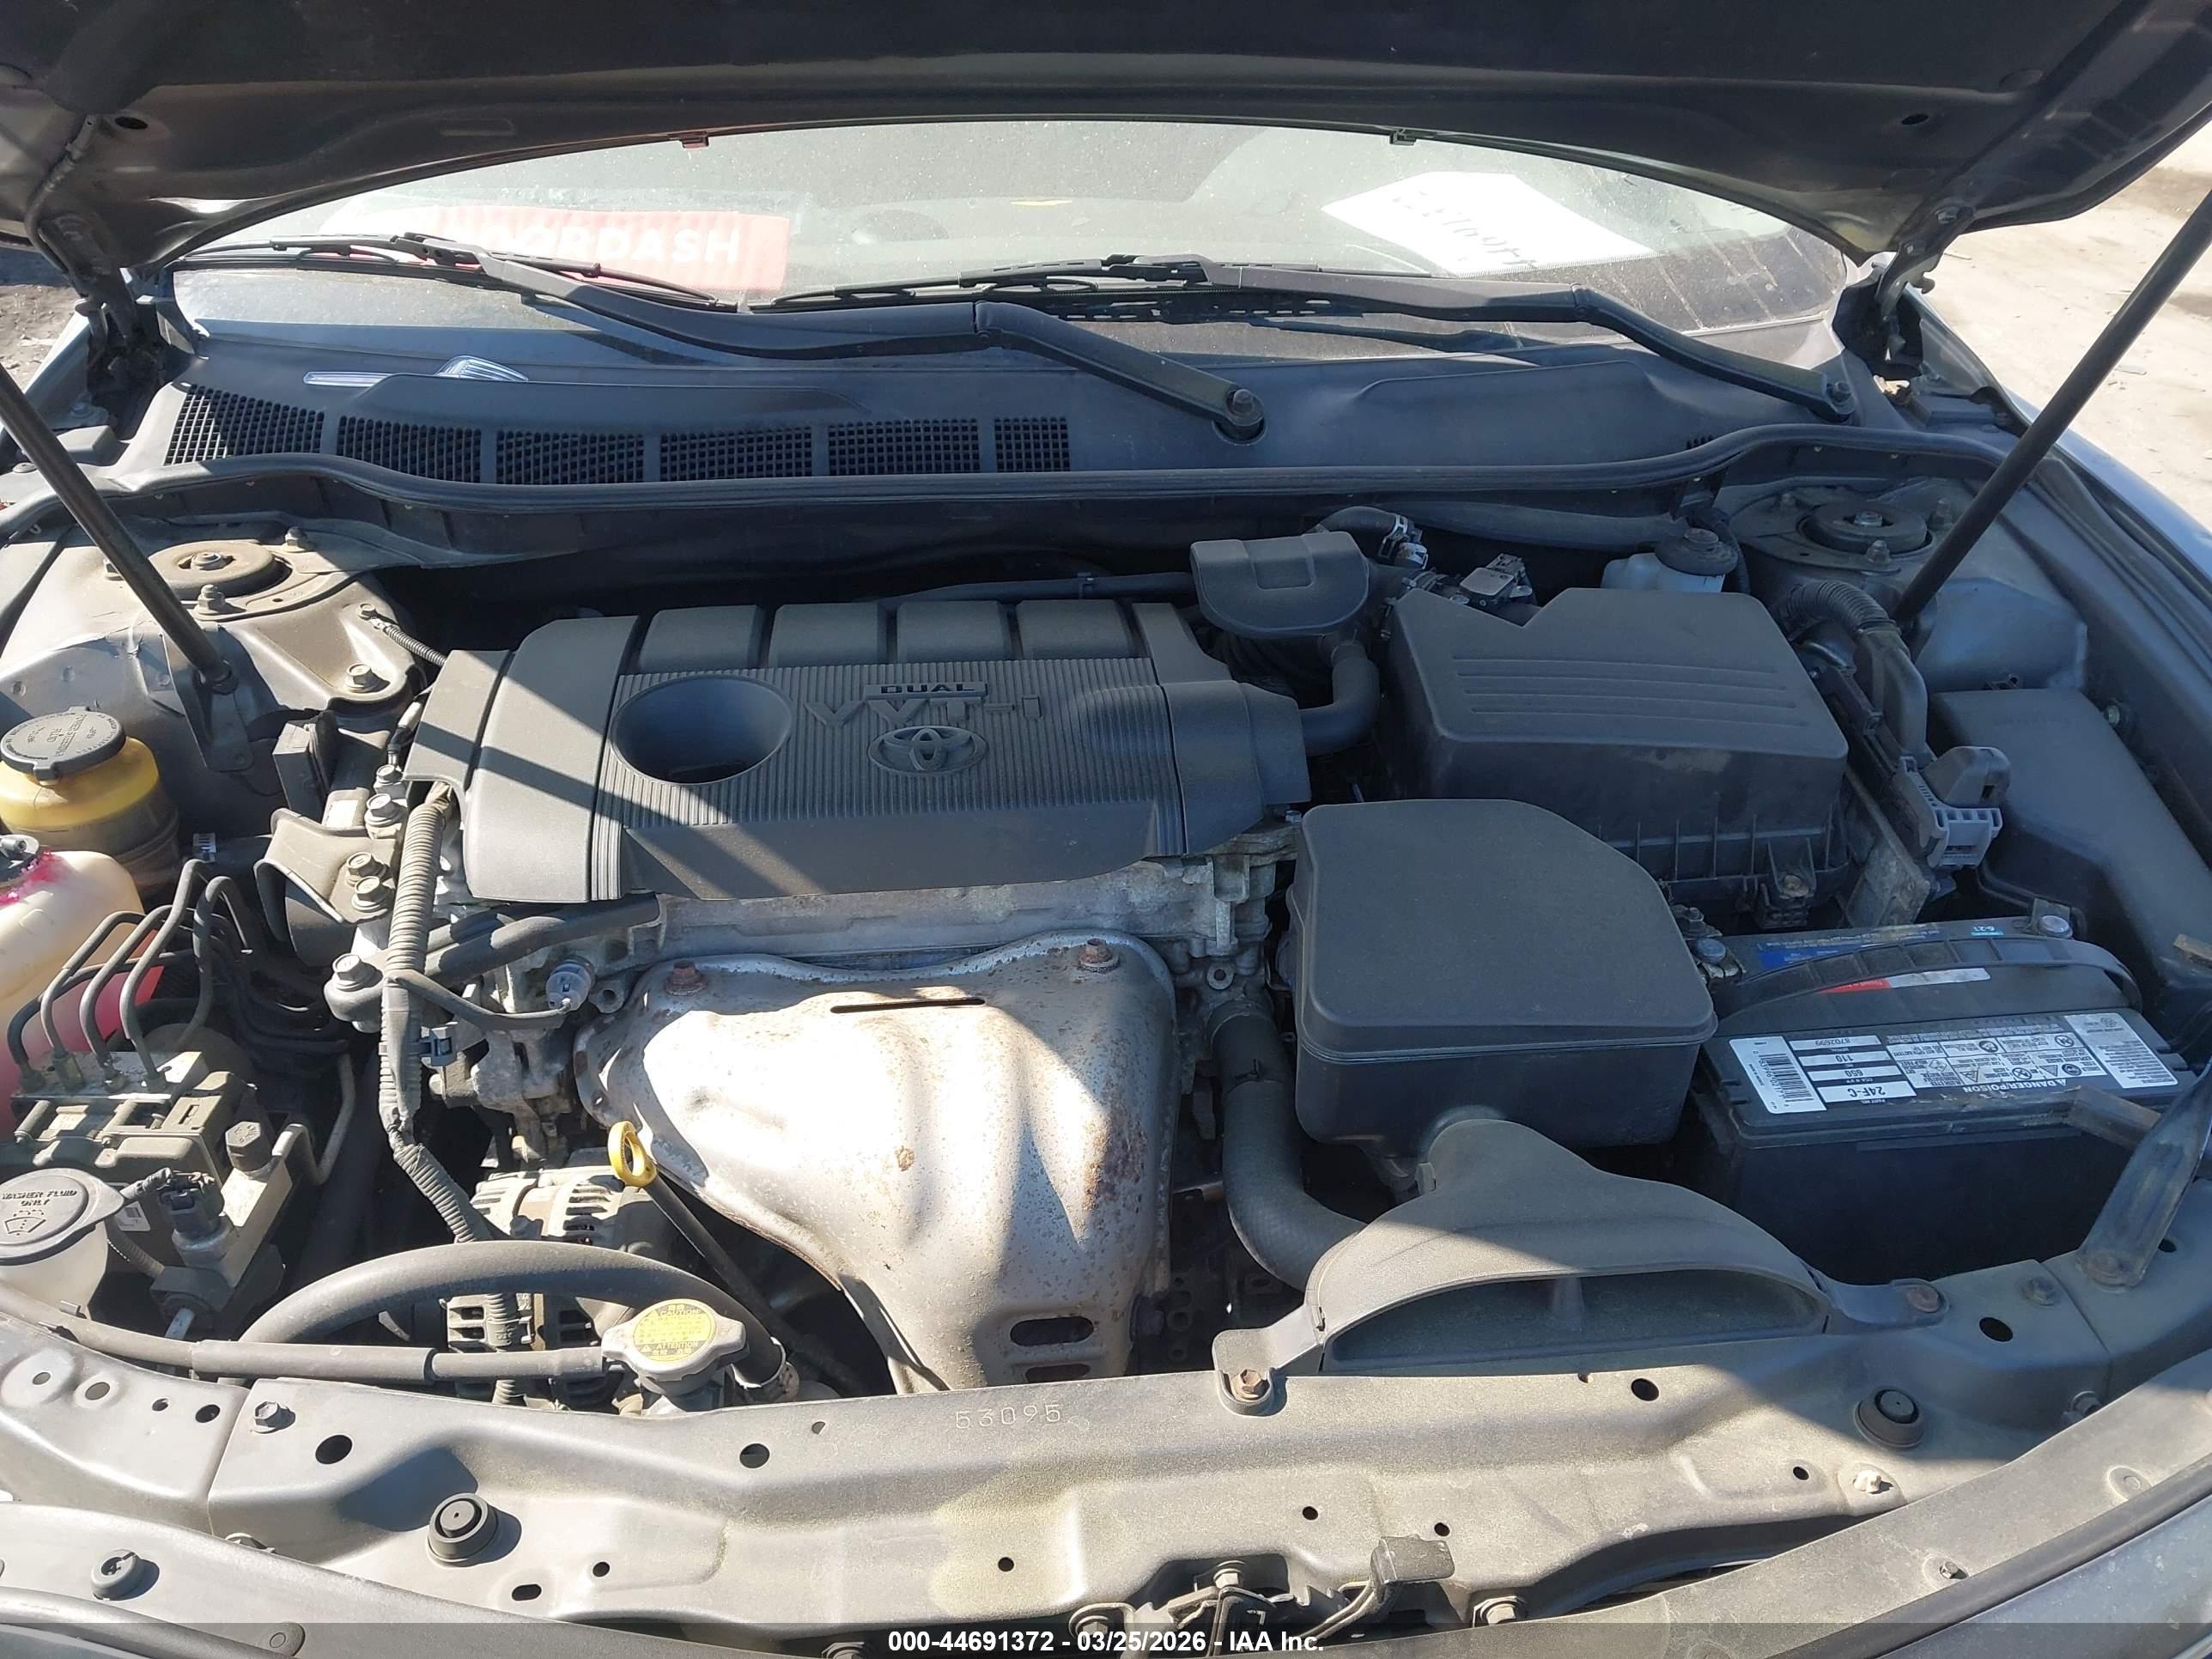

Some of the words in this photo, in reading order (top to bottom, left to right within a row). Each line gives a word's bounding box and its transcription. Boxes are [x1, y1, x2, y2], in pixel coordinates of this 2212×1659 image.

[881, 683, 976, 694] DUAL
[1846, 1069, 1863, 1078] 650
[1847, 1086, 1886, 1097] 24F-C
[46, 1189, 77, 1198] FLUID
[956, 1404, 1060, 1429] 53095
